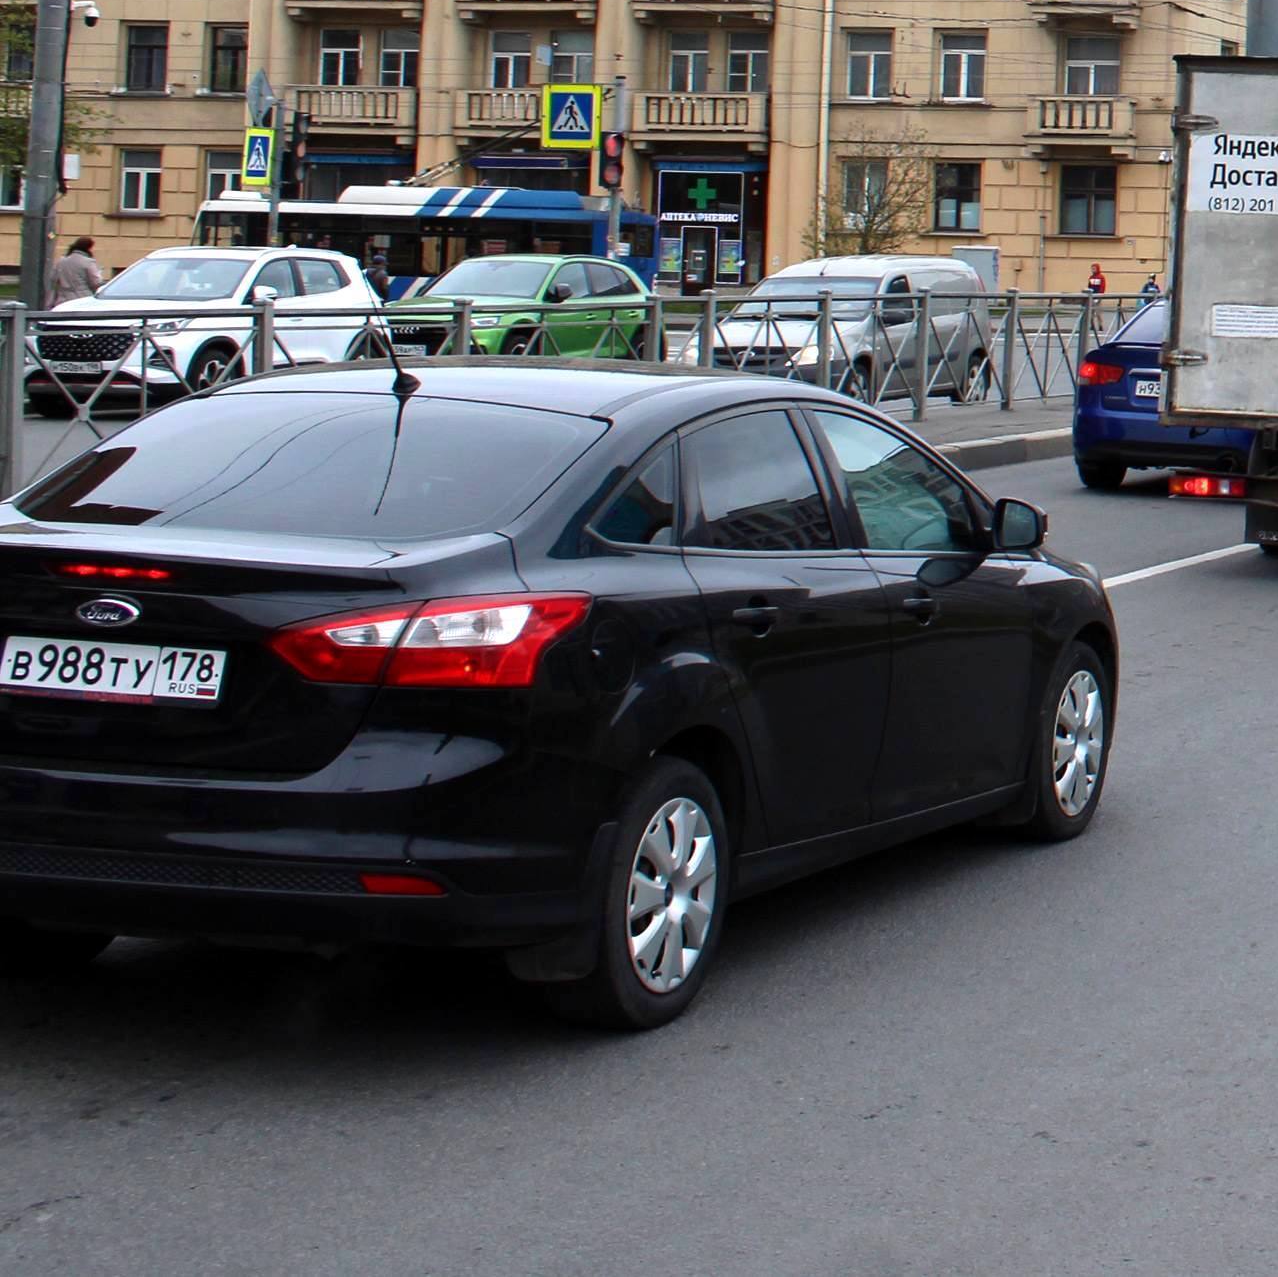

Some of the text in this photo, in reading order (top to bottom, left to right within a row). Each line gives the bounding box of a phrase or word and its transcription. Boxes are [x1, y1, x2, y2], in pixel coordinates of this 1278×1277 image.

[1208, 196, 1246, 213] (812)
[1249, 198, 1274, 212] 201
[660, 212, 739, 222] АПТЕКА НЕВИС
[87, 603, 121, 622] Ford
[11, 644, 215, 689] В988ТУ 178
[169, 682, 196, 695] RUS
